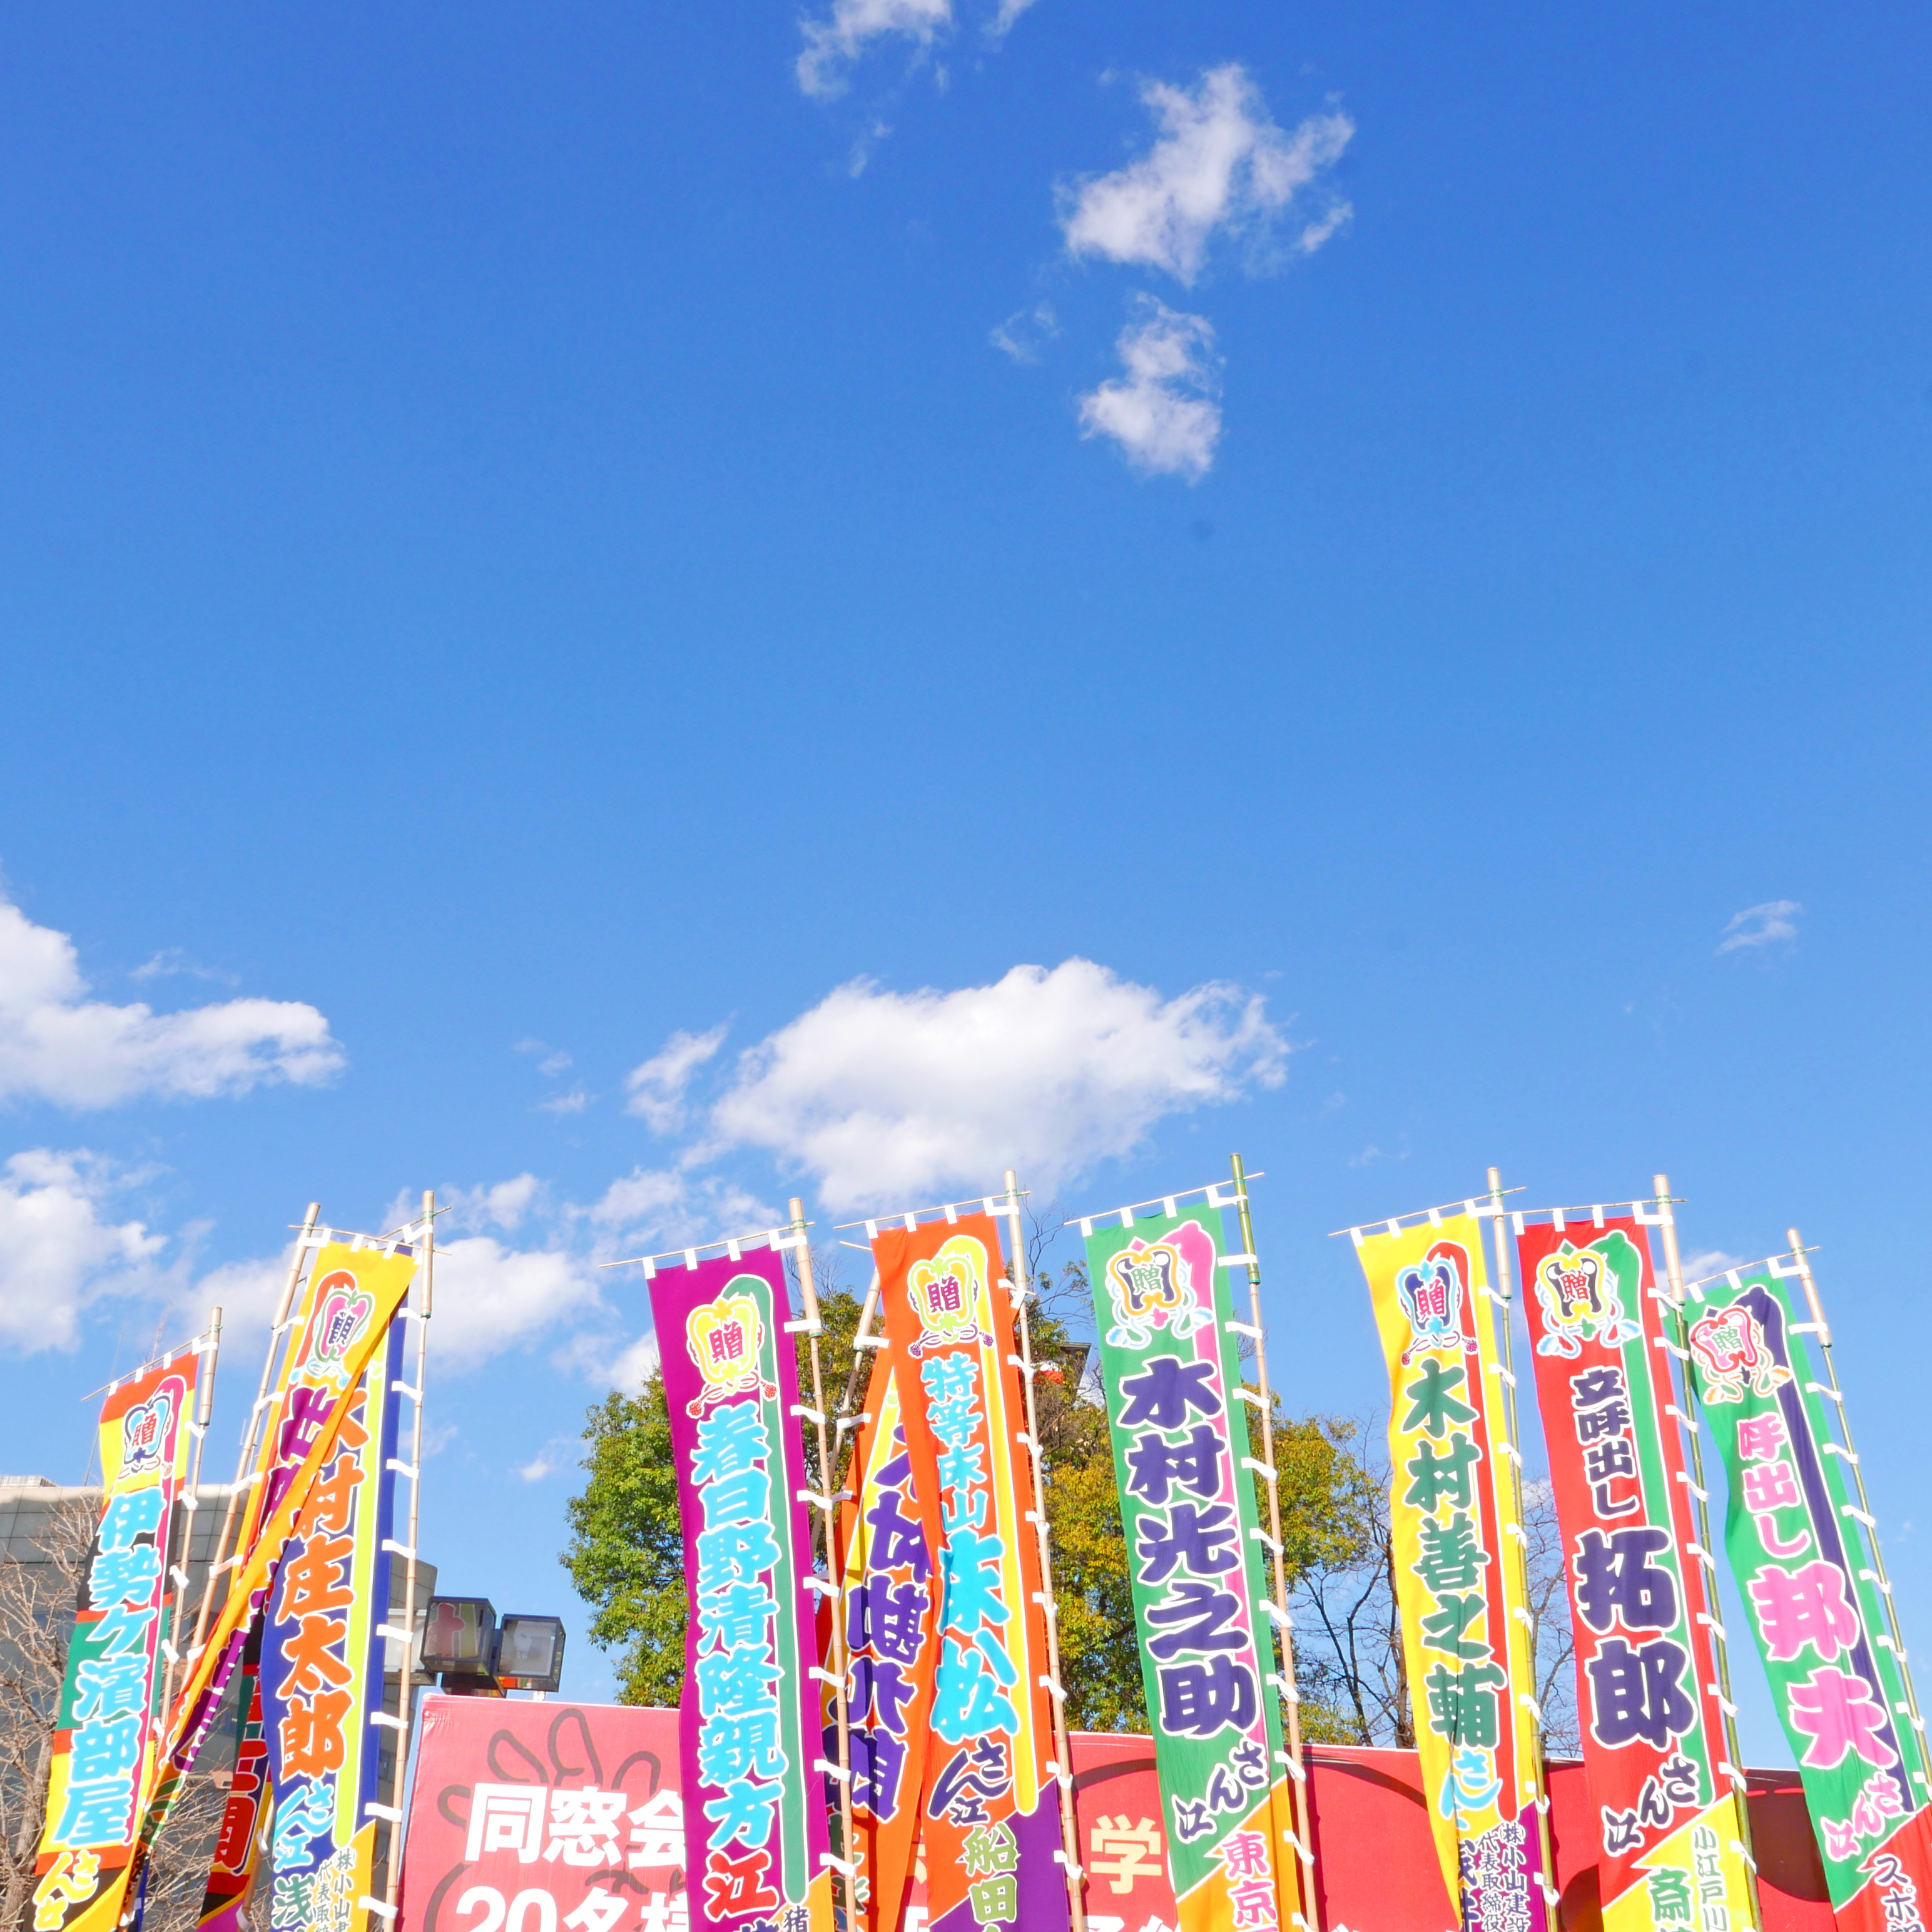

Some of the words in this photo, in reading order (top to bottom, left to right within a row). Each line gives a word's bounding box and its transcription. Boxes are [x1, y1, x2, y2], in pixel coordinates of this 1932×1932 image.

[927, 1276, 960, 1313] 贈
[1131, 1264, 1162, 1294] 贈
[1416, 1278, 1445, 1321] 贈
[1560, 1271, 1590, 1302] 贈
[709, 1321, 743, 1363] 贈
[132, 1413, 157, 1447] 贈
[465, 1782, 686, 1869] 同窓会
[312, 1859, 333, 1932] 代表取
[963, 1821, 1018, 1932] 船田
[1221, 1831, 1278, 1932] 東京
[1874, 1854, 1924, 1932] スポ
[272, 1873, 315, 1932] 浅
